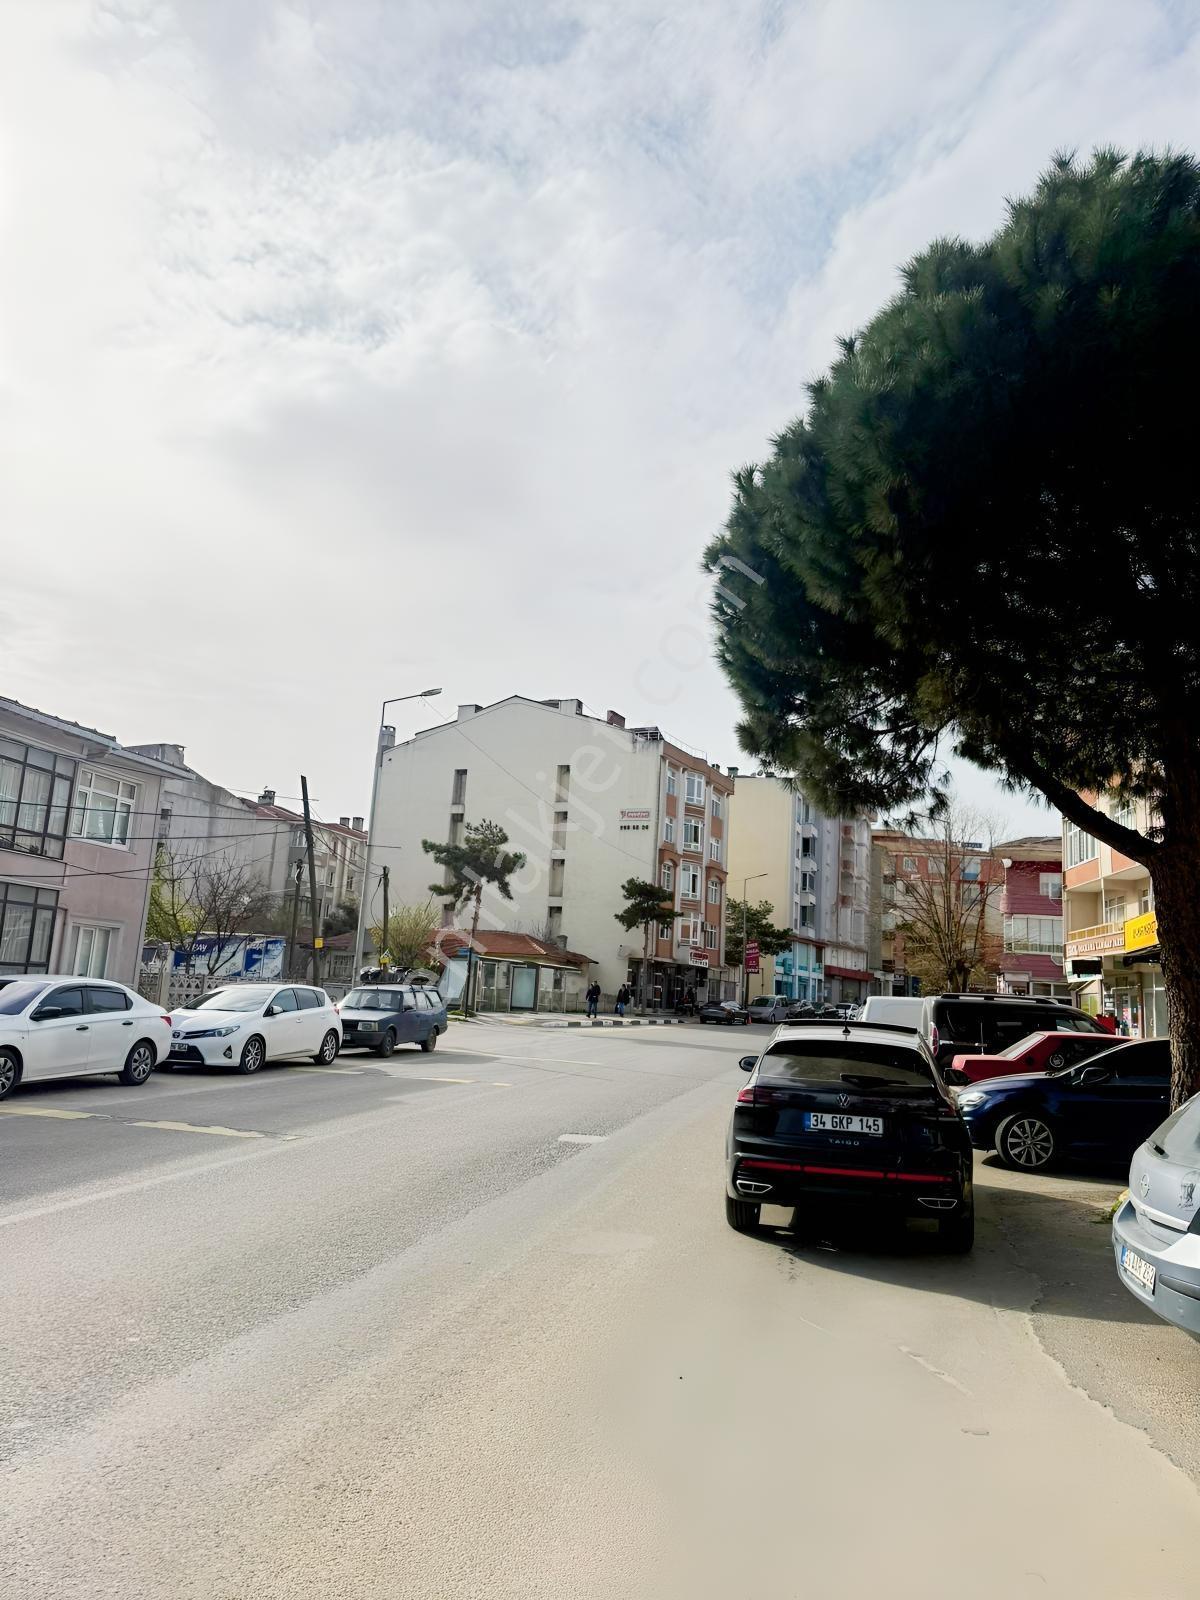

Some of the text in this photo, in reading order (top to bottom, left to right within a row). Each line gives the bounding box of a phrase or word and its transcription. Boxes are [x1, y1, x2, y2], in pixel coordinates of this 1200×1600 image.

[812, 1115, 880, 1132] 34 GKP 145
